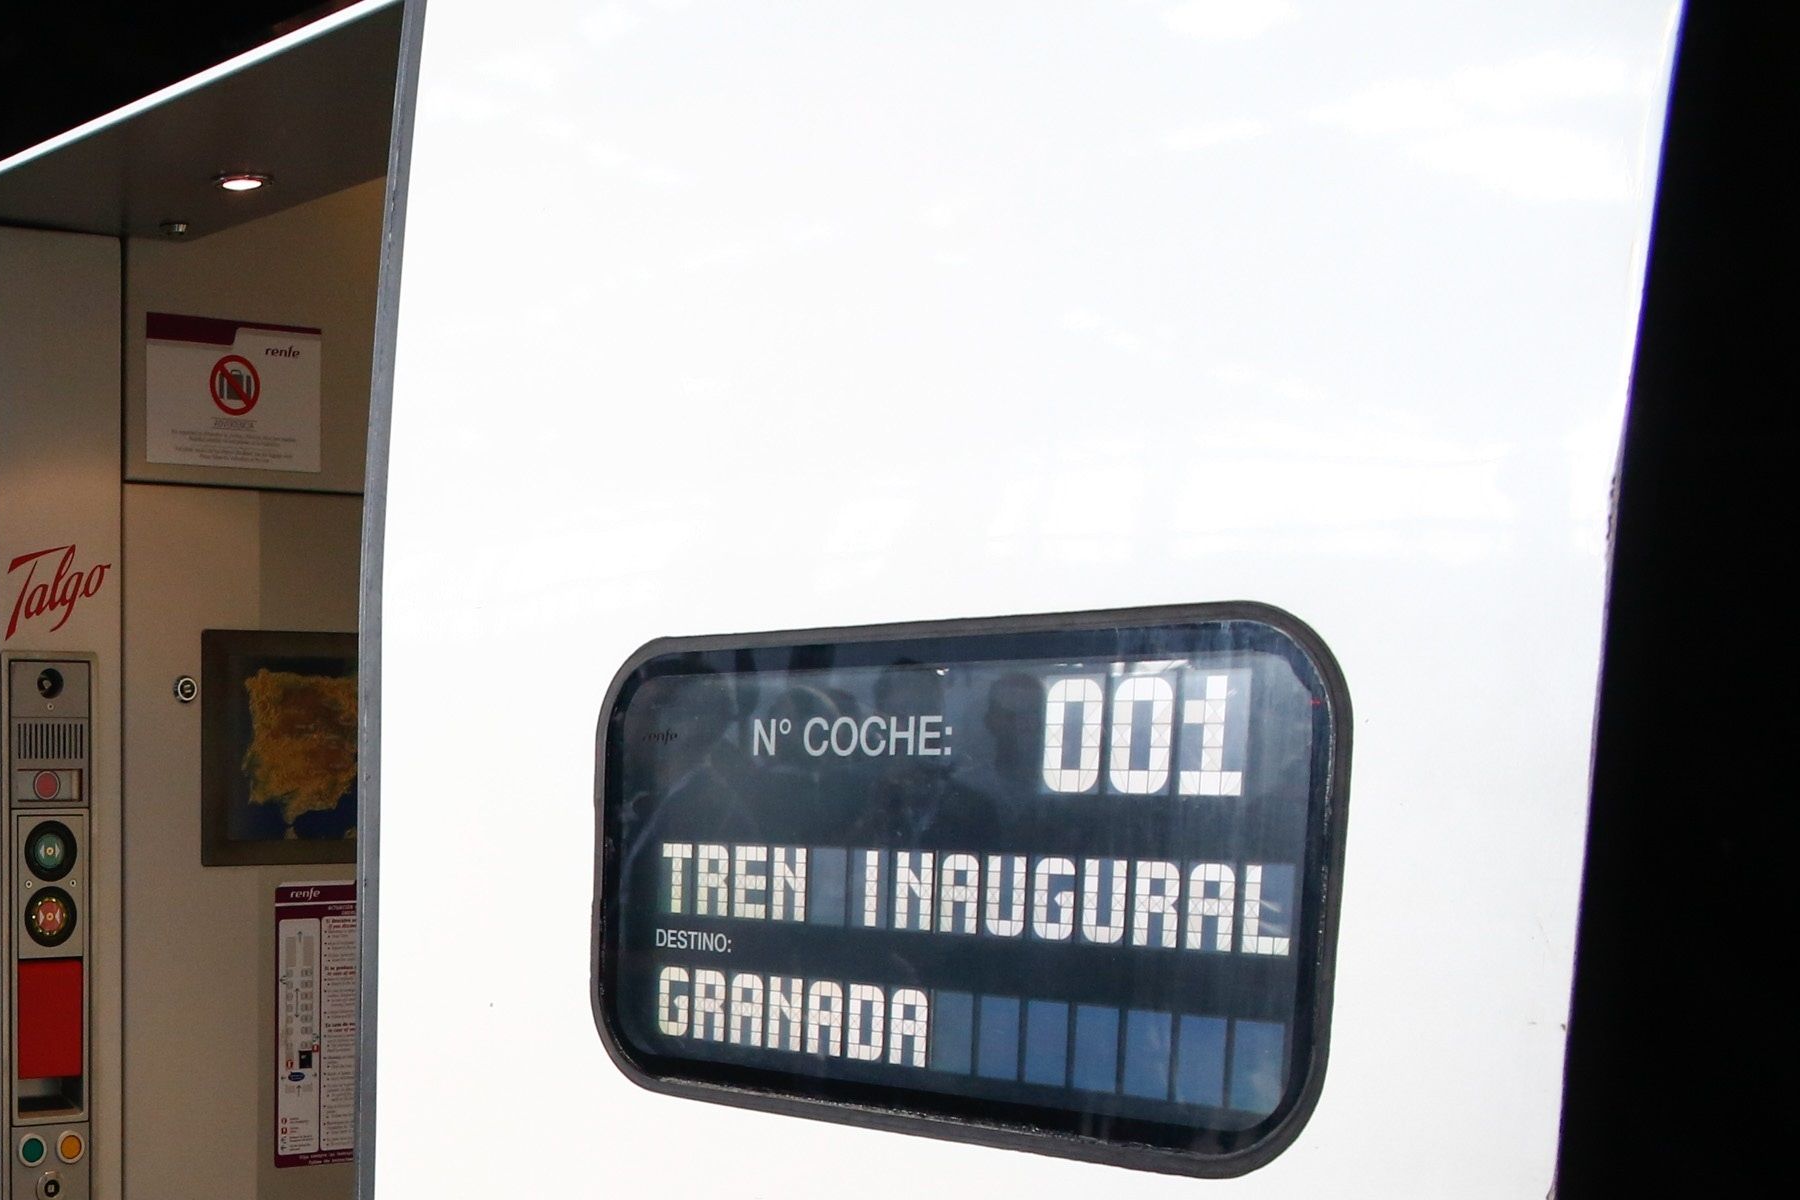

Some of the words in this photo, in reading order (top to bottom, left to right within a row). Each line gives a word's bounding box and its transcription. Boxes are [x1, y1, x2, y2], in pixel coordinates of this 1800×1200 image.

[265, 345, 300, 358] renfe
[4, 544, 112, 641] Talgo
[802, 714, 953, 757] COCHE:
[1042, 674, 1244, 797] 001
[290, 887, 321, 901] renfe
[655, 927, 733, 953] DESTINO:
[661, 842, 808, 922] TREN
[863, 849, 1292, 957] INAUGURAL
[657, 965, 930, 1069] GRANADA
